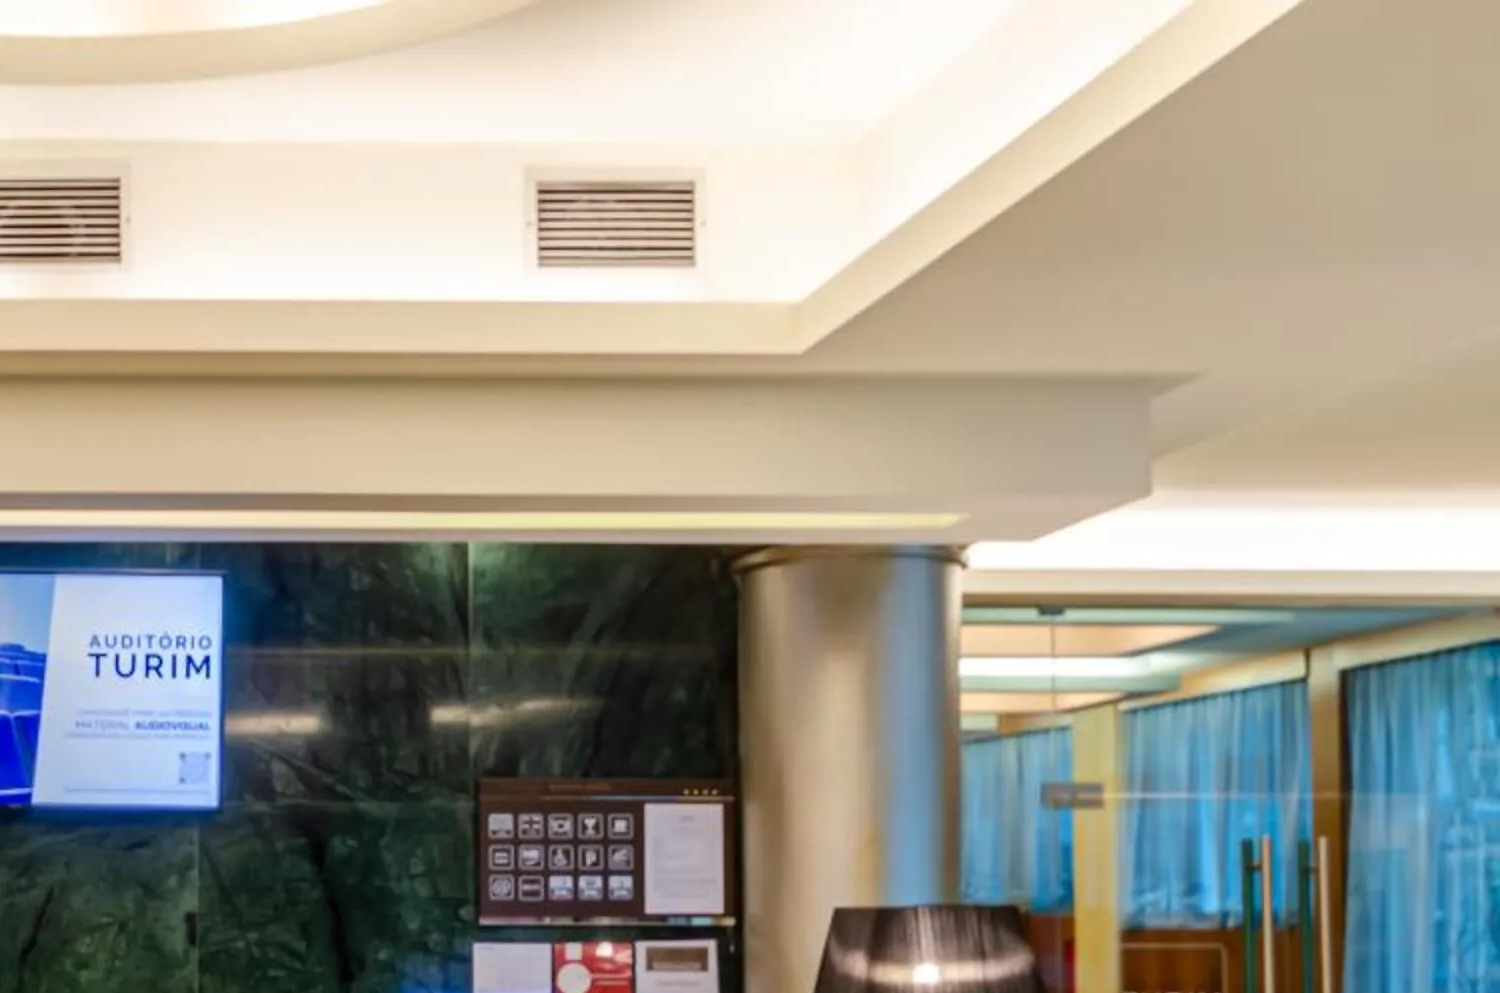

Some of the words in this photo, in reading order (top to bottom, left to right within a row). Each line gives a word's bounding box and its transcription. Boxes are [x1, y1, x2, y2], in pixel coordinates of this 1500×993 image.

[88, 631, 213, 650] AUDITÓRIO
[87, 653, 212, 679] TURIM
[134, 720, 211, 731] AUDIOVISUAL
